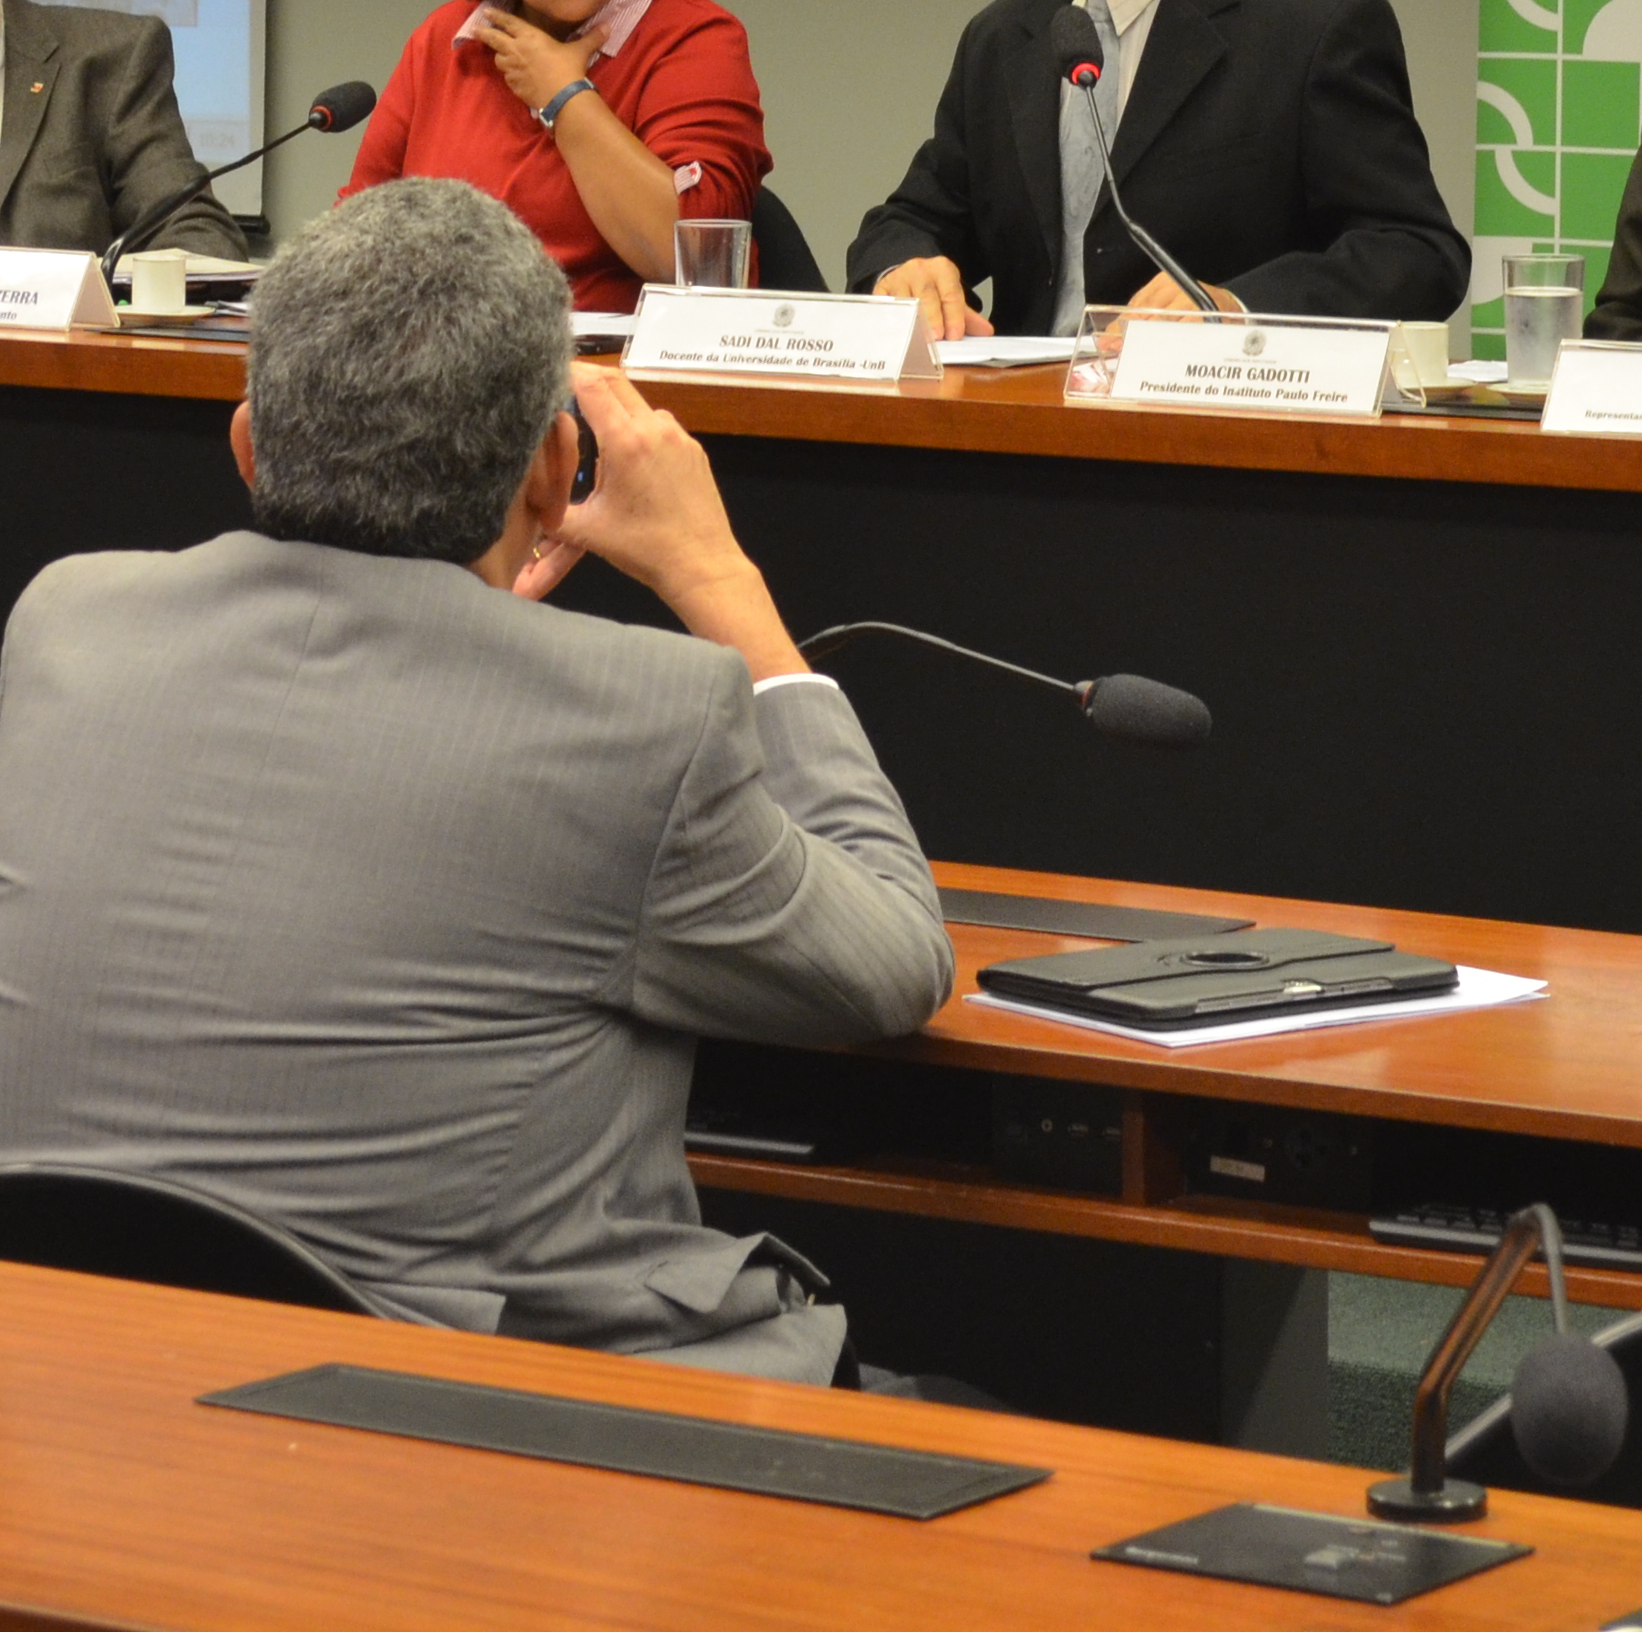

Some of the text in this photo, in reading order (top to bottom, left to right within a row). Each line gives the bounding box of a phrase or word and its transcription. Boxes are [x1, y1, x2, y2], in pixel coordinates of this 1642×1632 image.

[719, 335, 835, 353] SADI DAL ROSSO
[659, 350, 703, 363] Docente
[706, 352, 720, 363] da
[723, 353, 793, 367] Universidade
[796, 356, 810, 367] de
[812, 356, 856, 369] Brasília
[1185, 364, 1310, 384] MOACIR GADOTTI
[1140, 381, 1348, 403] Presidente do Instituto Paulo Freire
